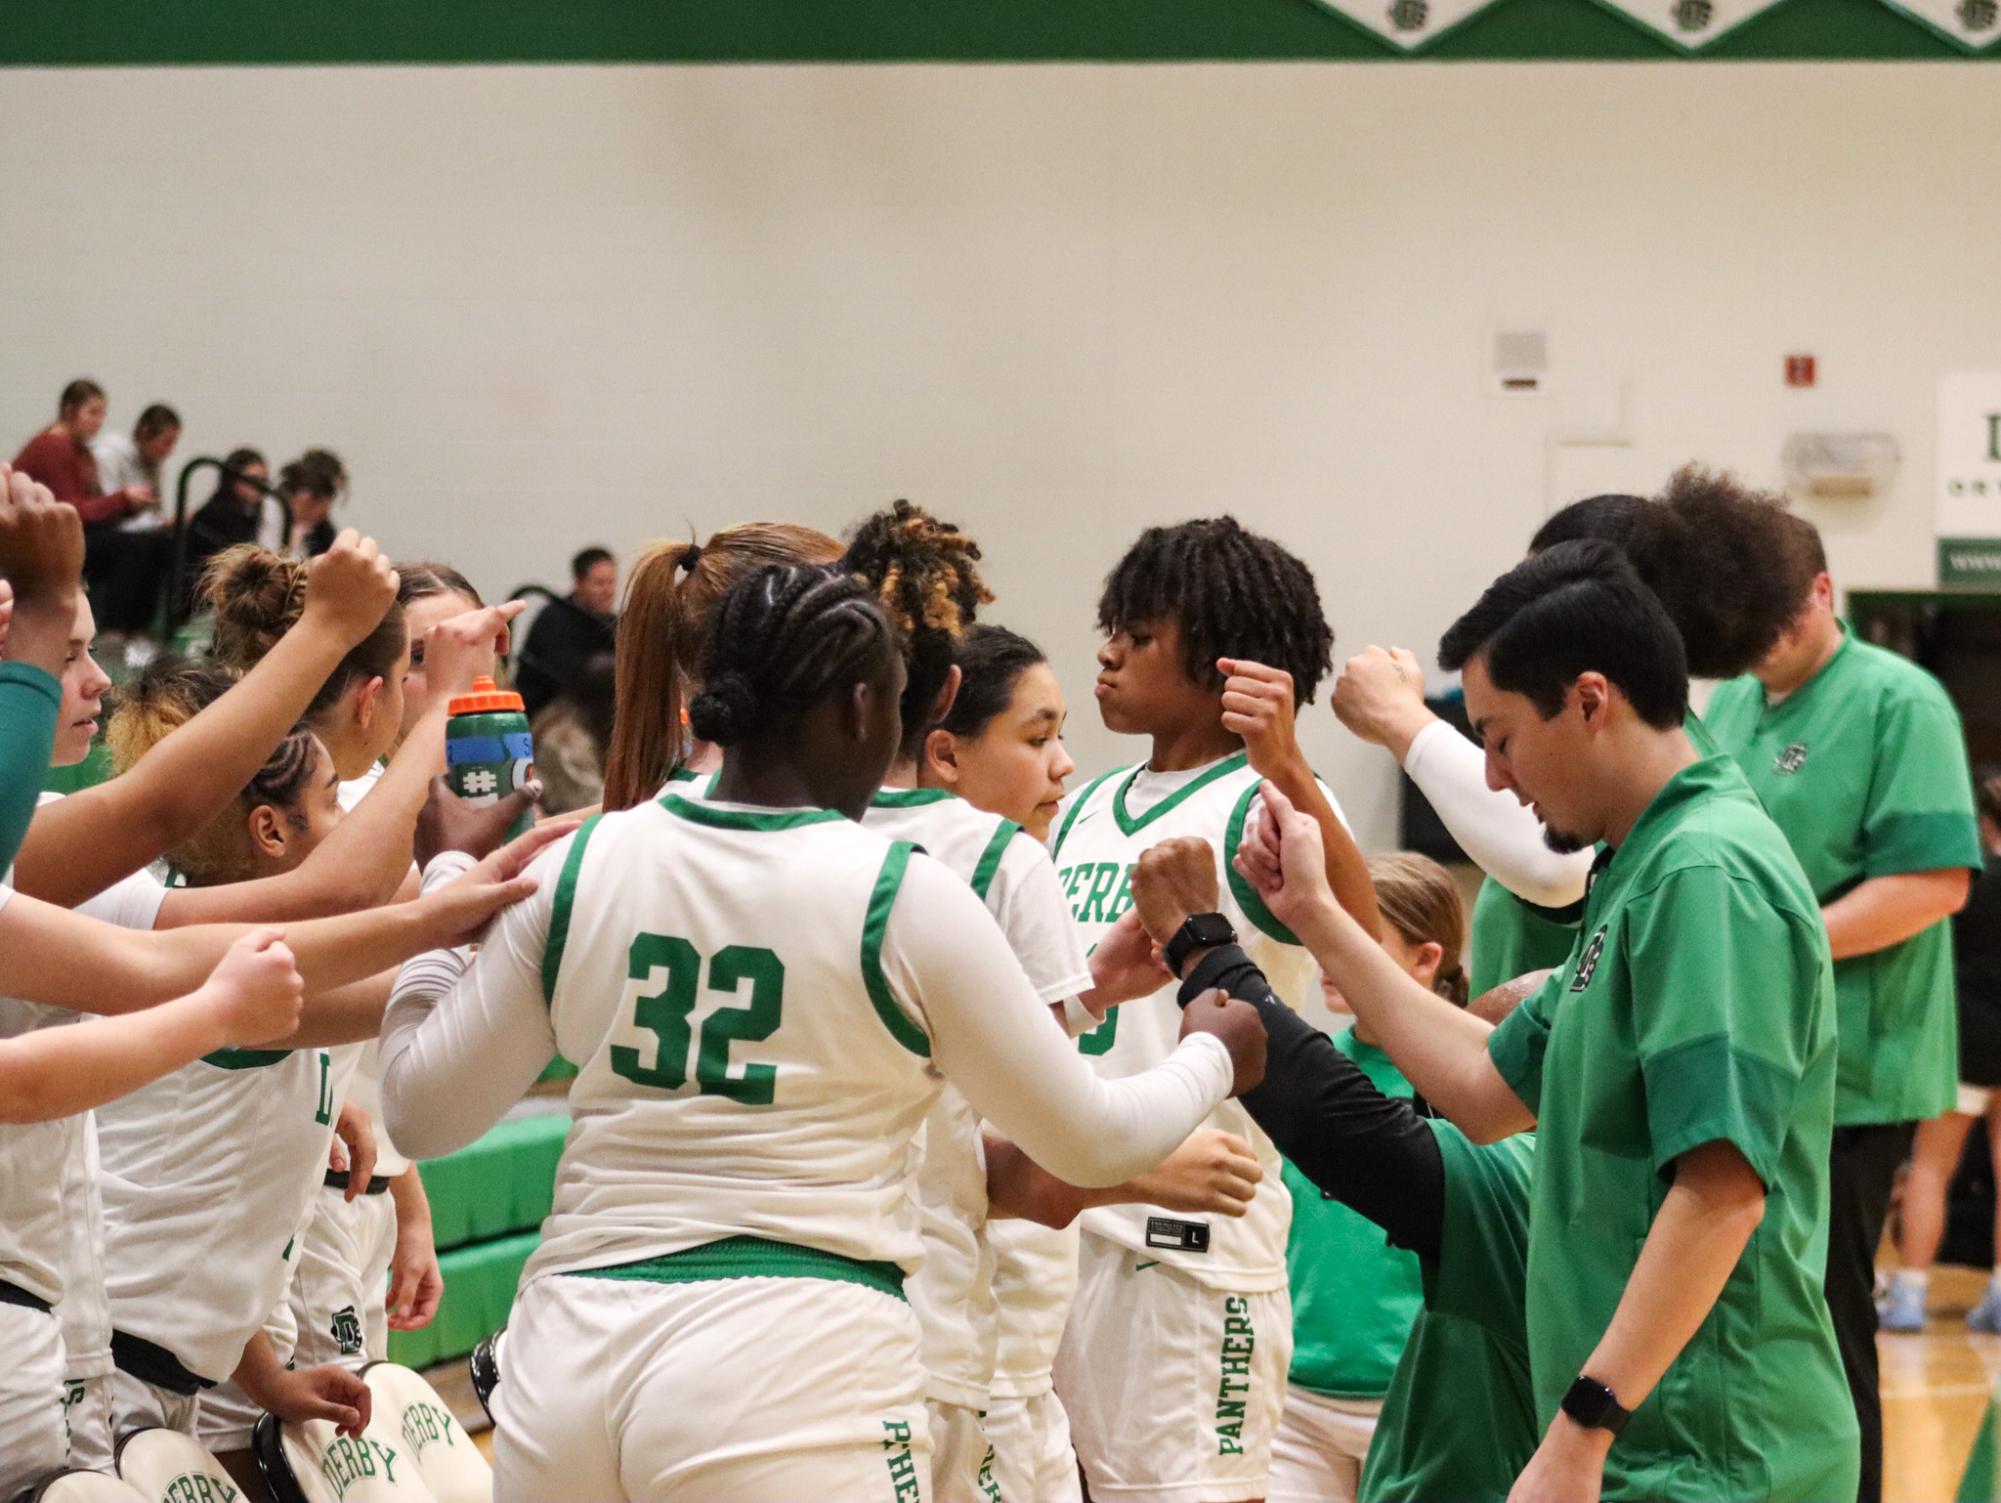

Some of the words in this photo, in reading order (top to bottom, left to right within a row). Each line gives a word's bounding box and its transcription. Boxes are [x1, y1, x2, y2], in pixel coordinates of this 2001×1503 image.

[1058, 862, 1138, 923] ERB
[610, 932, 785, 1105] 32
[1191, 1231, 1199, 1244] L
[1215, 1296, 1255, 1456] PANTHERS
[402, 1403, 454, 1465] DERBY
[163, 1472, 238, 1503] ERBY
[321, 1436, 396, 1503] DERBY
